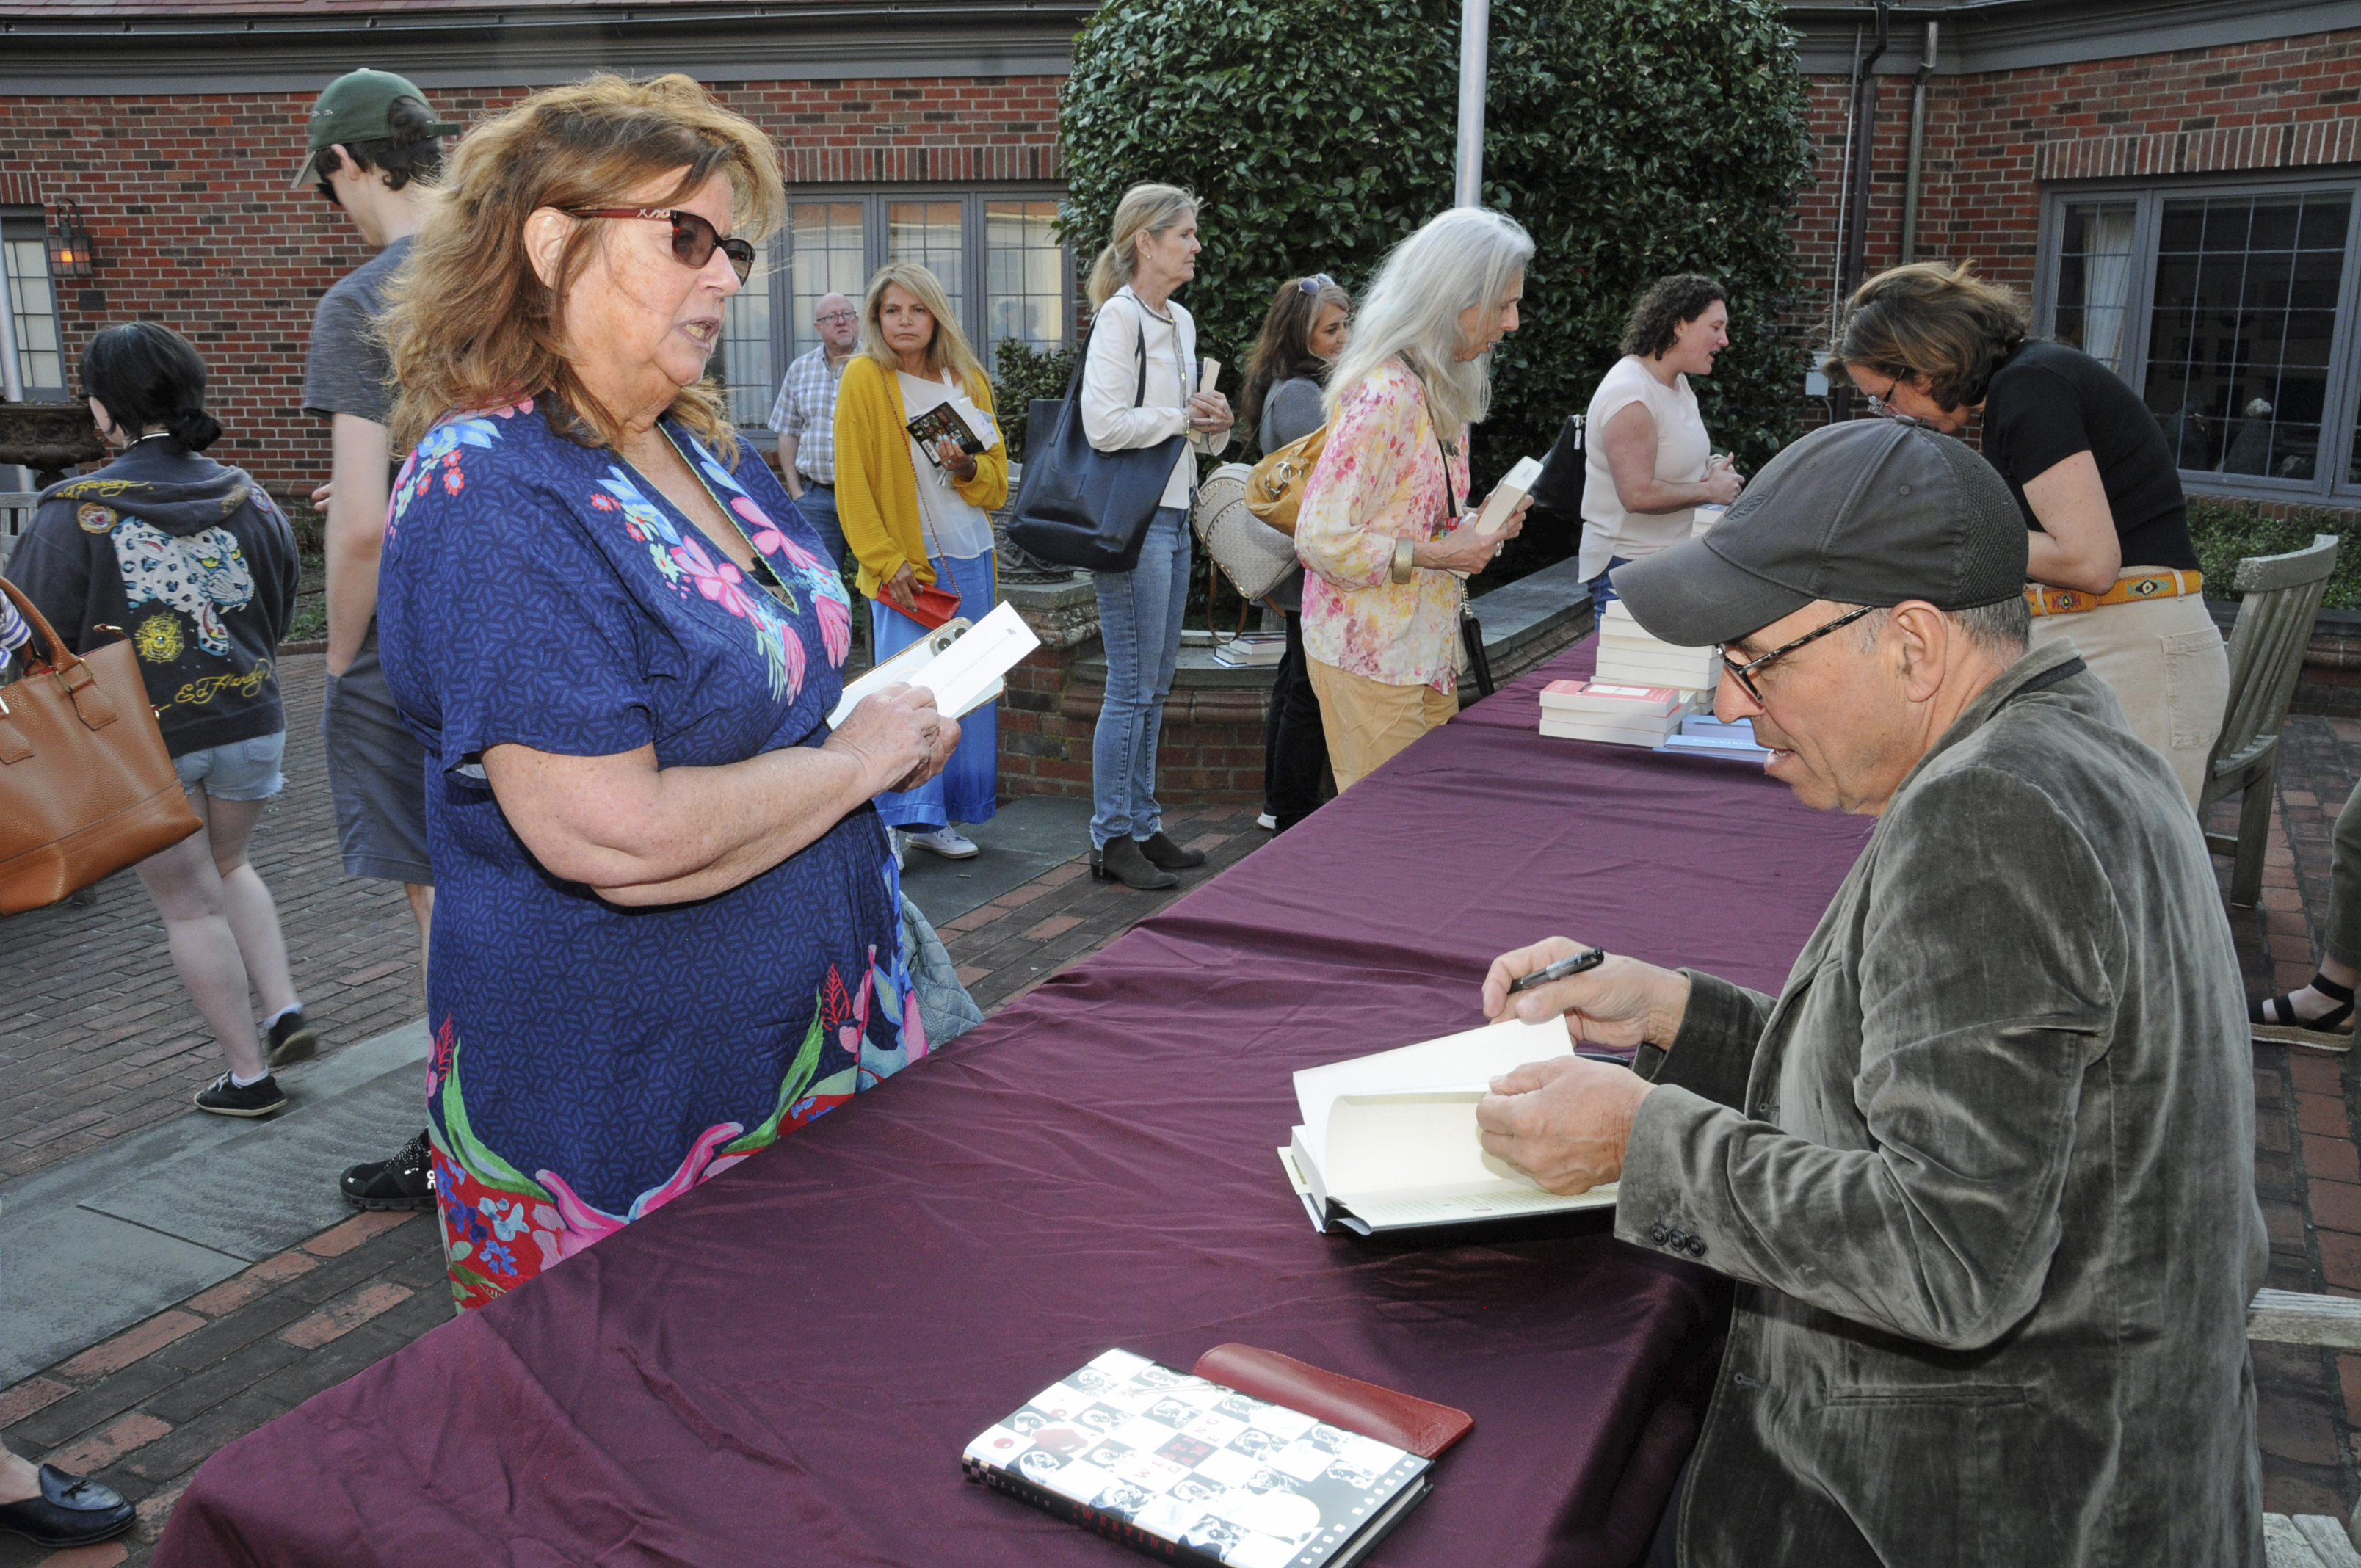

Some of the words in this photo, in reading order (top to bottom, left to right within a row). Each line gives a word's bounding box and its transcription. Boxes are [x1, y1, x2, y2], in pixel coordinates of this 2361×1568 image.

[174, 680, 210, 703] Ed
[1134, 1418, 1220, 1478] WESTING
[1167, 1435, 1220, 1473] GAME
[1082, 1507, 1175, 1556] WESTING
[1298, 1523, 1346, 1568] LLEN
